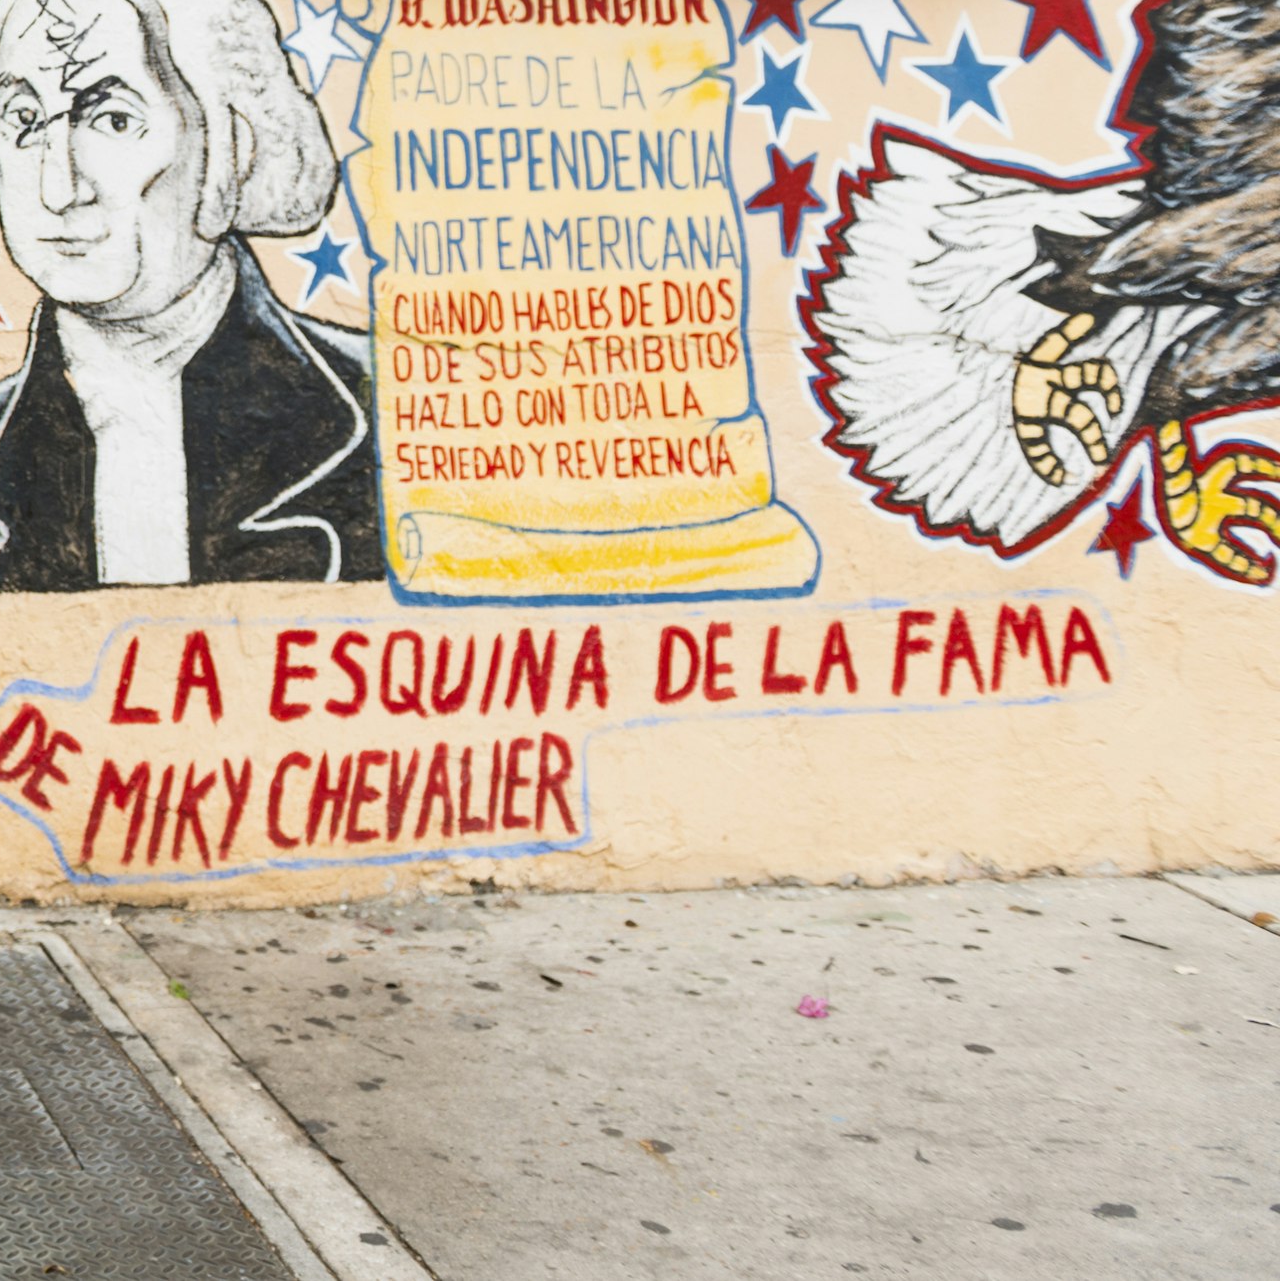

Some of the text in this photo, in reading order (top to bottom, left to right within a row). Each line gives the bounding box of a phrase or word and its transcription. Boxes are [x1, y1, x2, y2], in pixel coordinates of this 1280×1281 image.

[391, 50, 646, 110] PADRE DE LA
[394, 128, 728, 192] INDEPENDENCIA
[394, 215, 741, 276] NORTEAMERICANA
[513, 285, 613, 333] HABLES
[619, 282, 655, 328] DE
[663, 279, 736, 325] DIOS
[393, 326, 739, 383] O DE SUS ATRIBUTOS
[516, 389, 567, 428] CON
[571, 380, 652, 423] TODA
[660, 379, 704, 420] LA
[397, 441, 525, 484] SERIEDAD
[527, 442, 547, 478] Y
[109, 603, 1111, 725] LA ESQUINA DE LA FAMA
[81, 730, 579, 869] MIKY CHEVALIER
